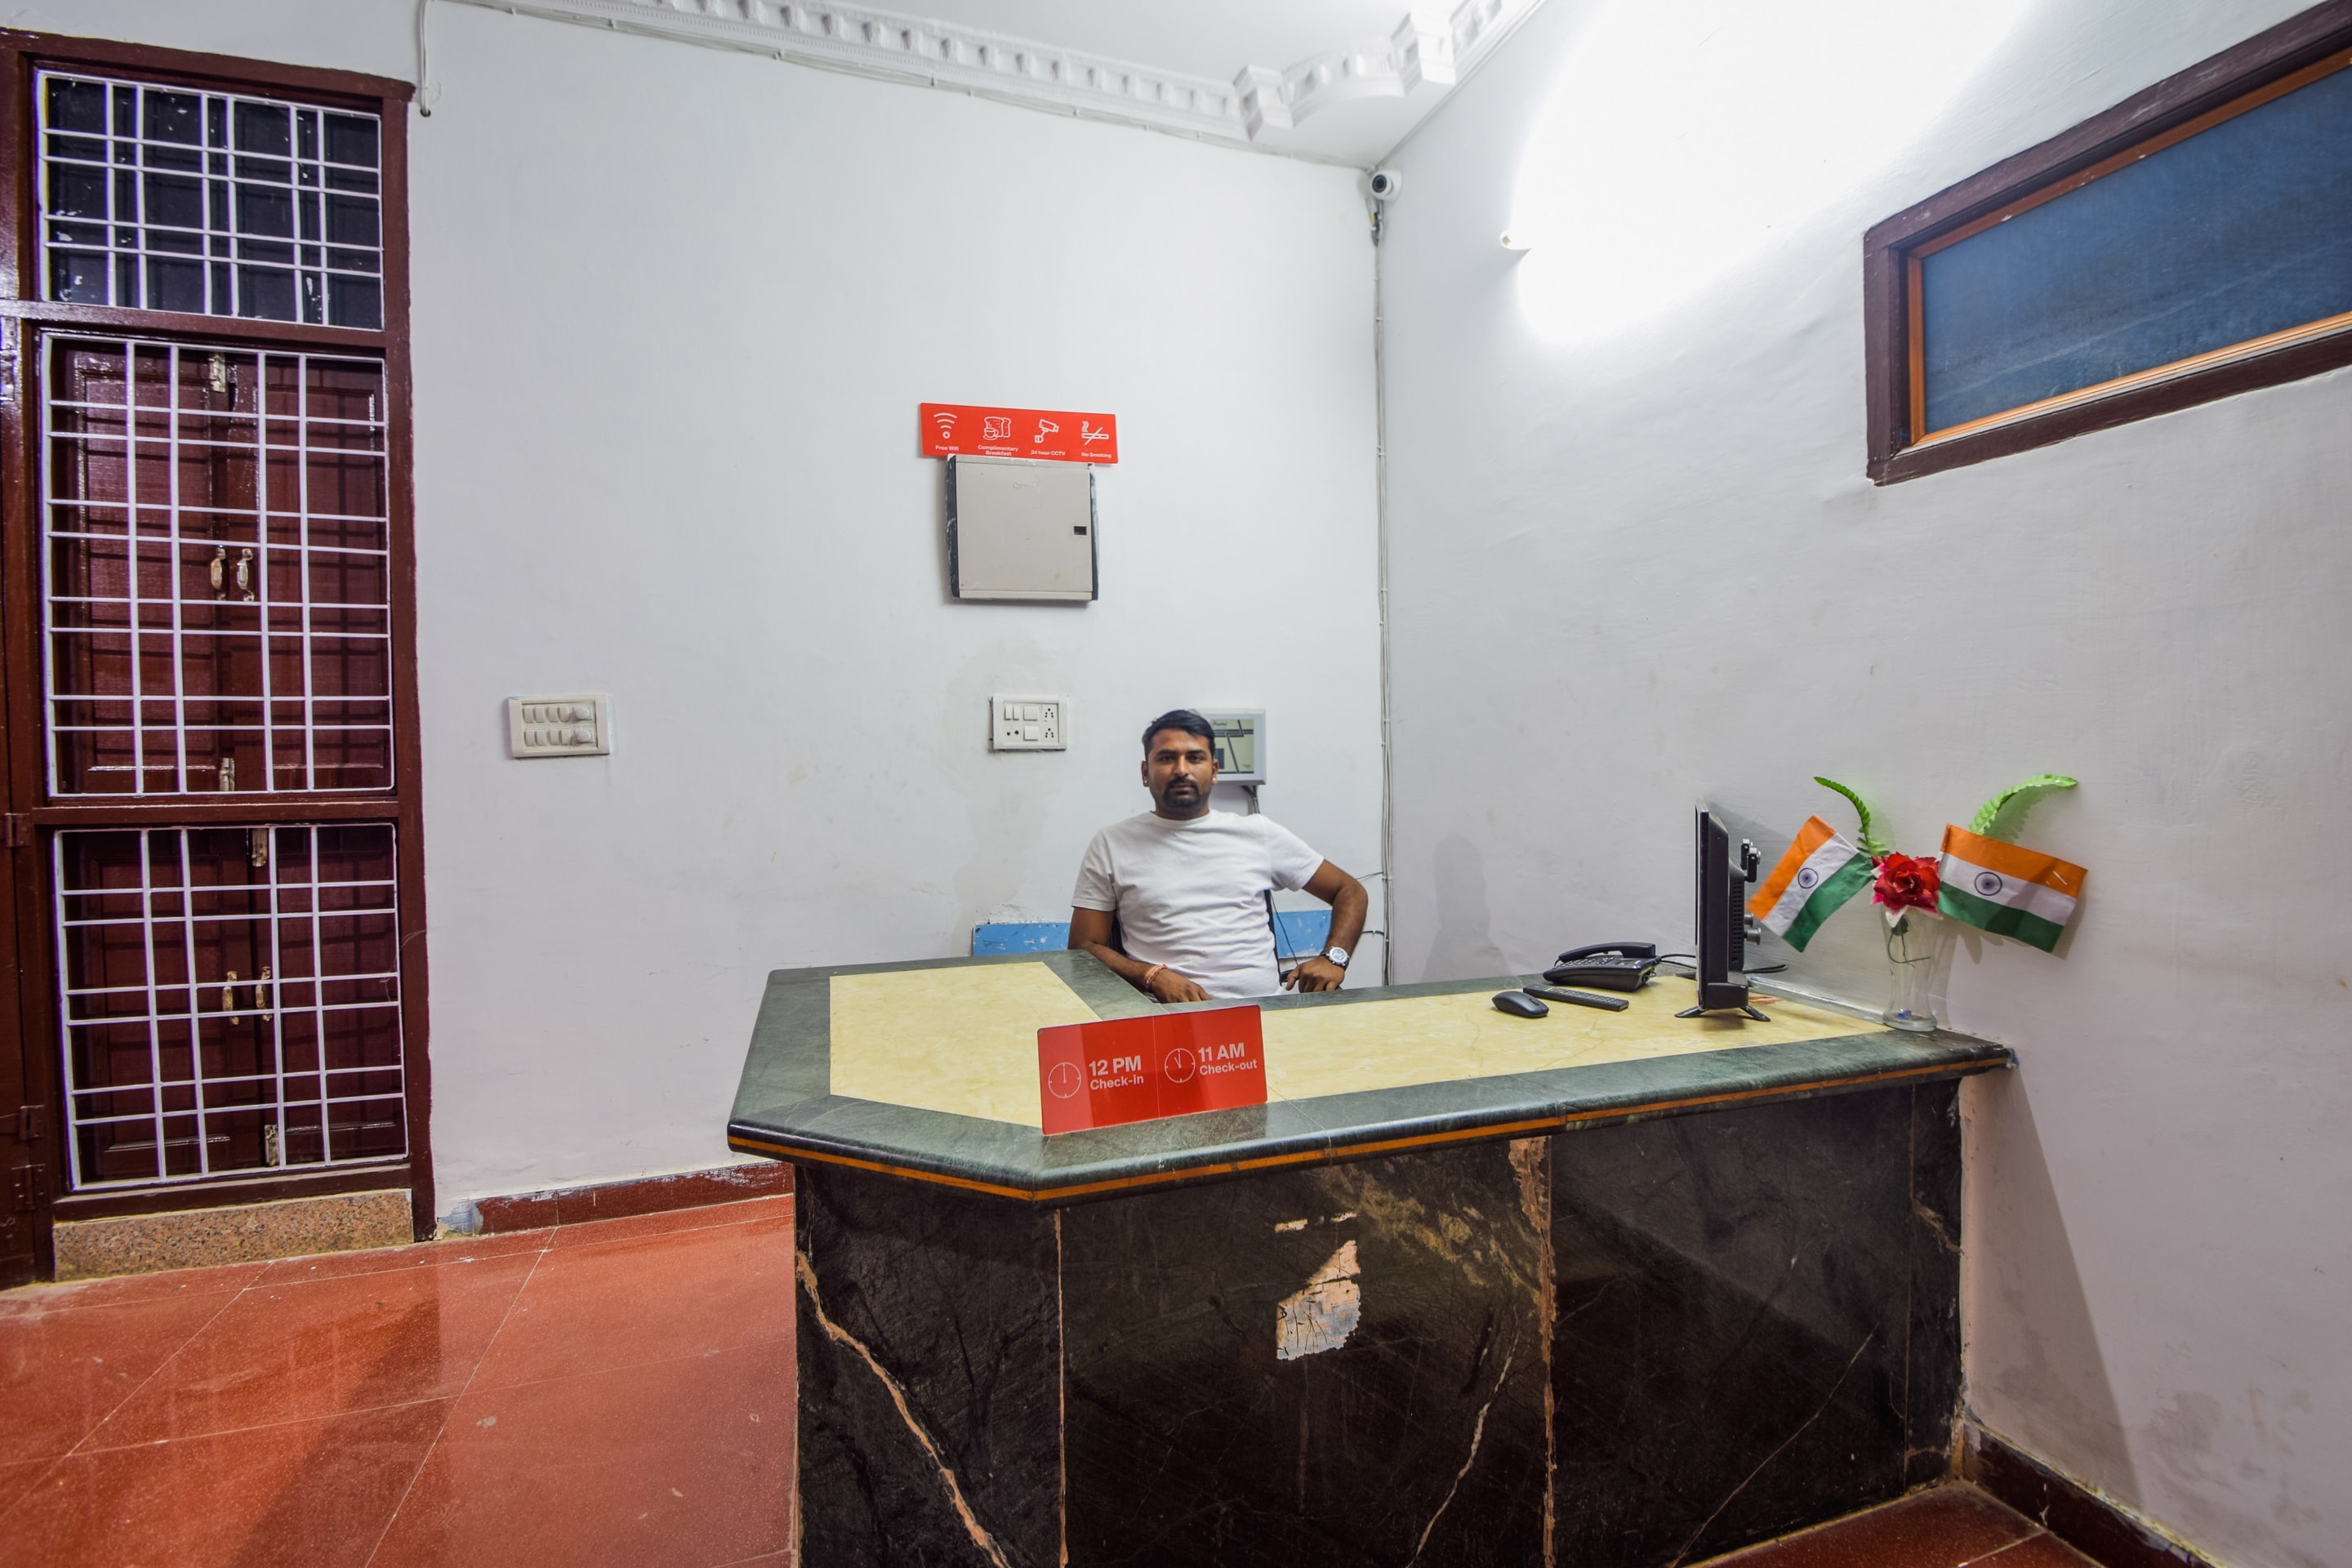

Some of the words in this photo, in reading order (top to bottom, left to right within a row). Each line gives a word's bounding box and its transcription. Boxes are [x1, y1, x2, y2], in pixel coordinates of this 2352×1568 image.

[1198, 1046, 1213, 1062] 11
[1217, 1043, 1245, 1059] AM
[1089, 1060, 1108, 1076] 12
[1113, 1055, 1141, 1073] PM
[1200, 1058, 1258, 1076] Check-out
[1089, 1075, 1143, 1090] Check-in
